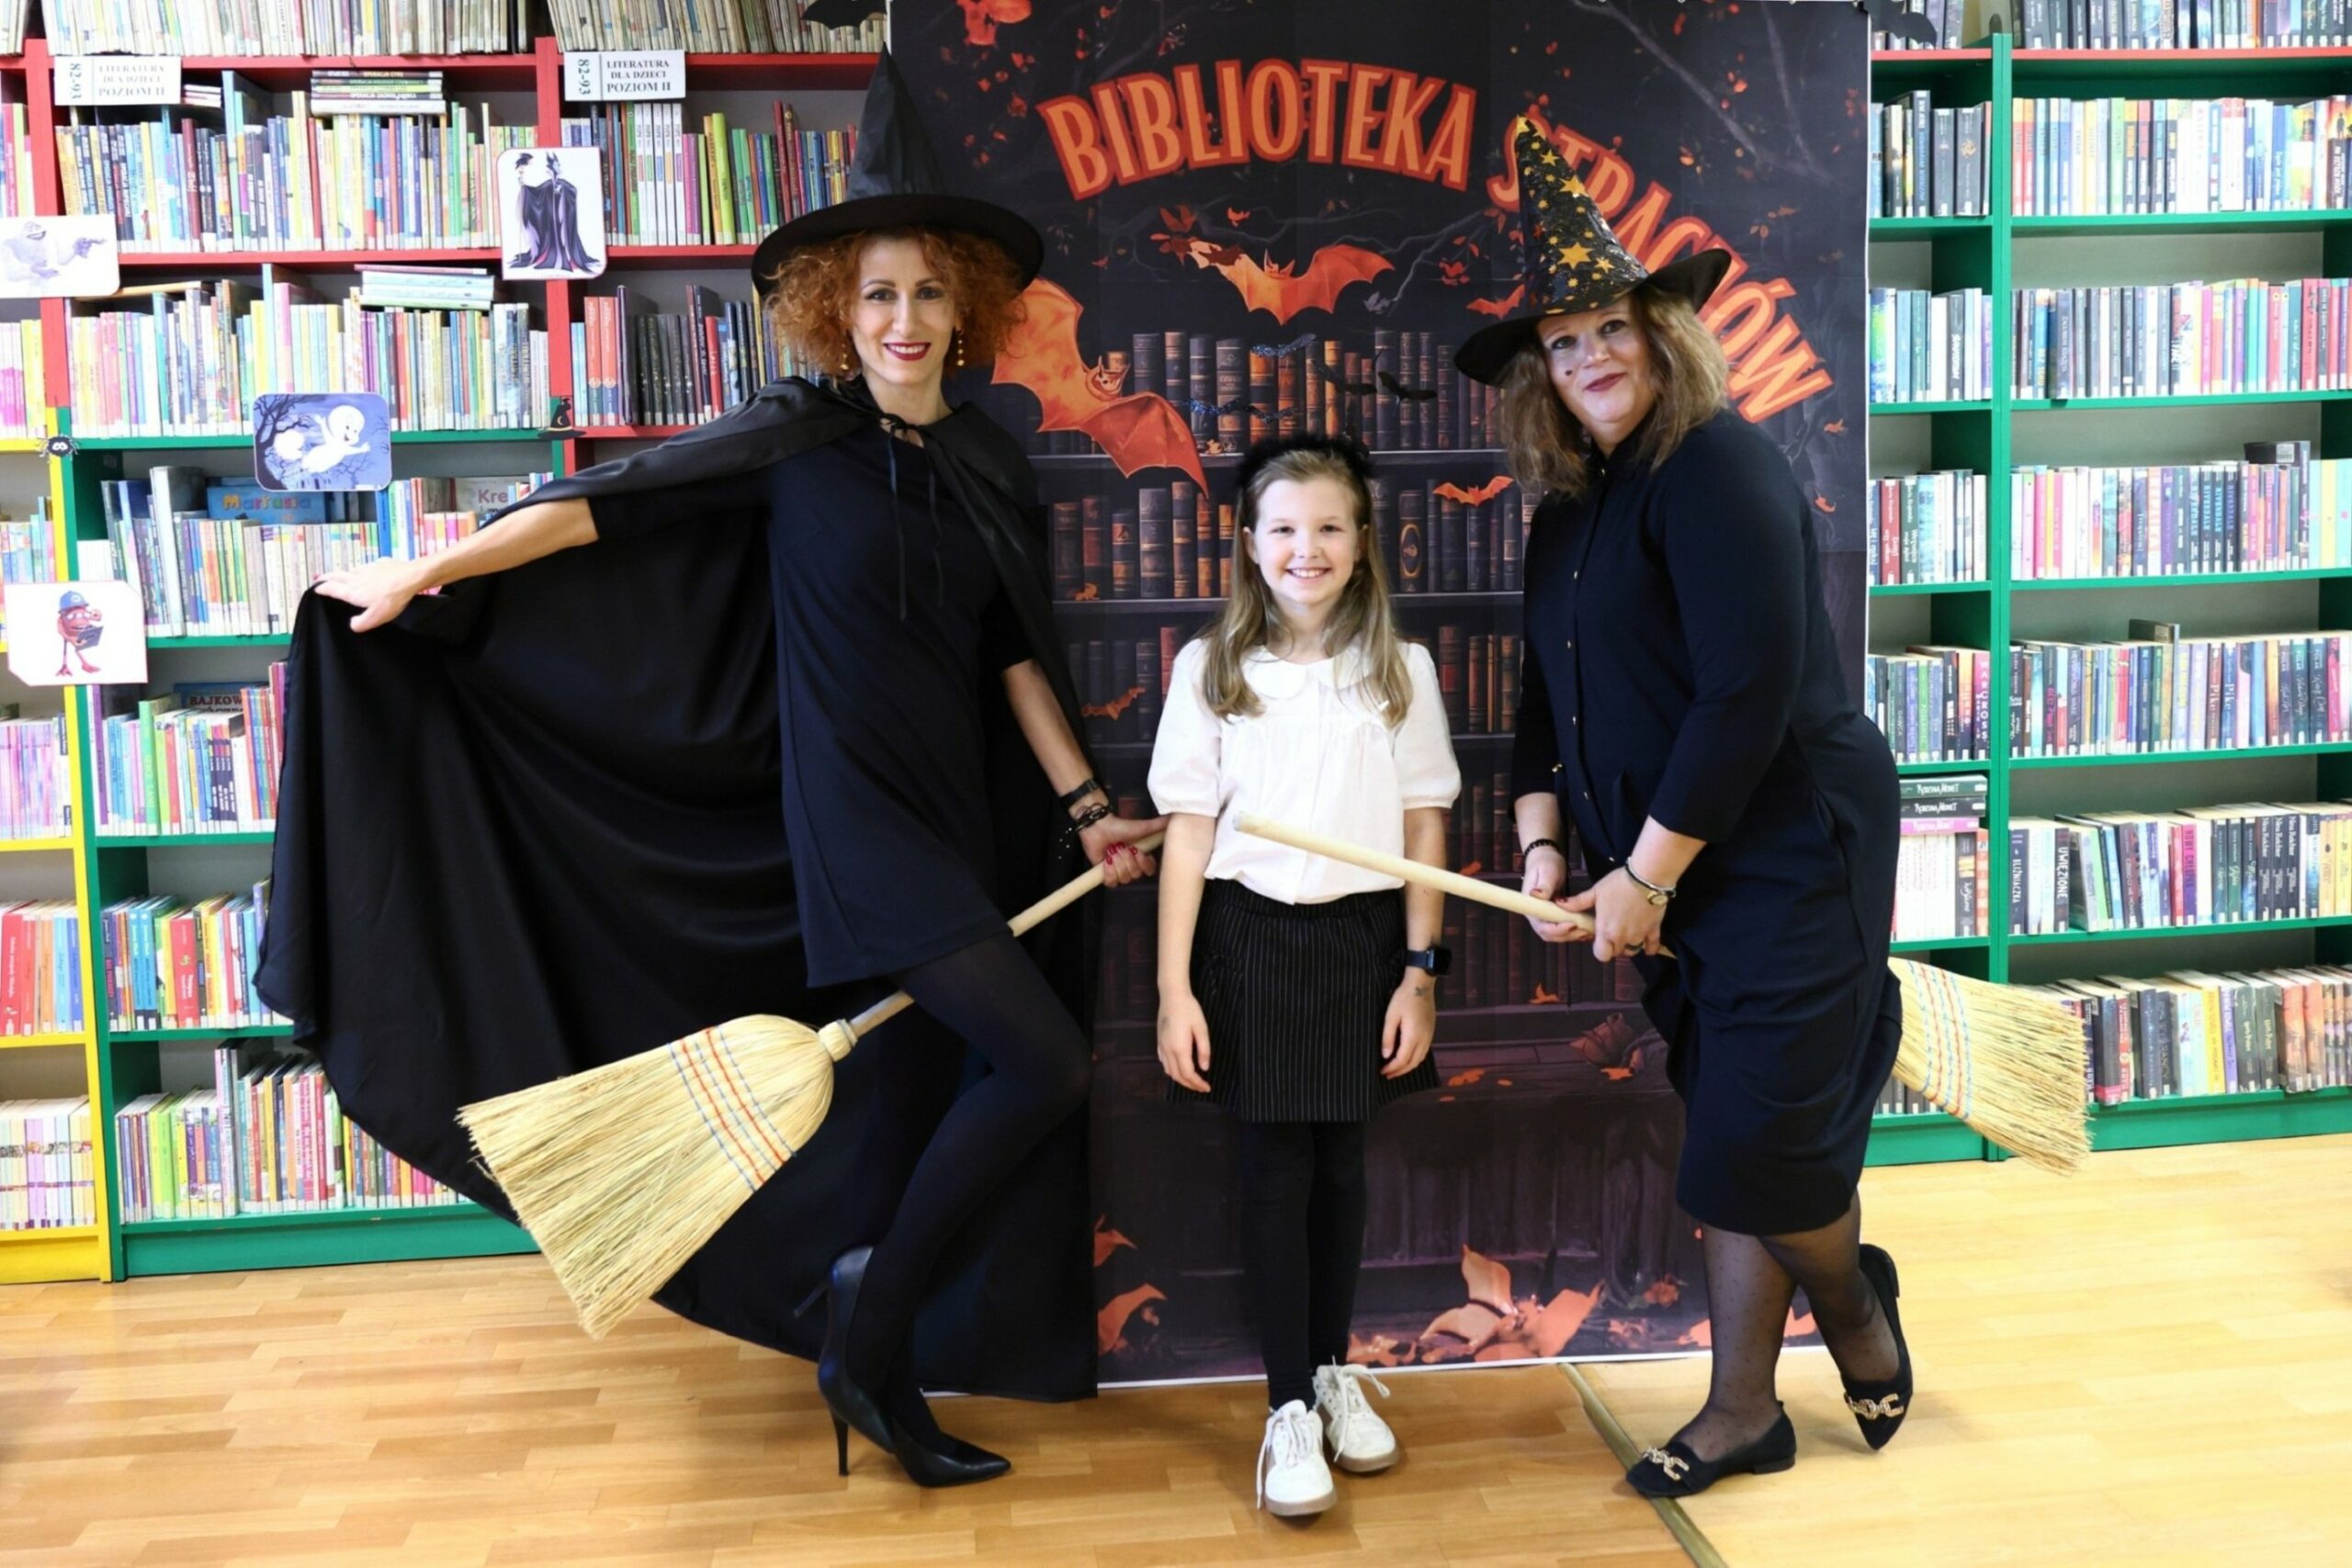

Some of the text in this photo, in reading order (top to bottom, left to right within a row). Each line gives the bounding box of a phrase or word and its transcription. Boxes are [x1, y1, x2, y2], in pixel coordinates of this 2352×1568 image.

[98, 64, 164, 73] LITERATURA
[578, 59, 591, 95] 82-93
[606, 60, 669, 69] LITERATURA
[633, 71, 666, 79] DZIECI
[98, 87, 153, 96] POZIOM
[606, 82, 671, 93] POZIOM II
[1037, 59, 1477, 200] BIBLIOTEKA
[1487, 113, 1833, 423] STRACÓW
[2210, 684, 2220, 711] Pike
[2224, 683, 2234, 710] Pike
[2288, 816, 2297, 856] Nina Reichter
[2012, 858, 2024, 904] BLIŹNIACZKA
[2056, 846, 2069, 899] UWIĘZIONE
